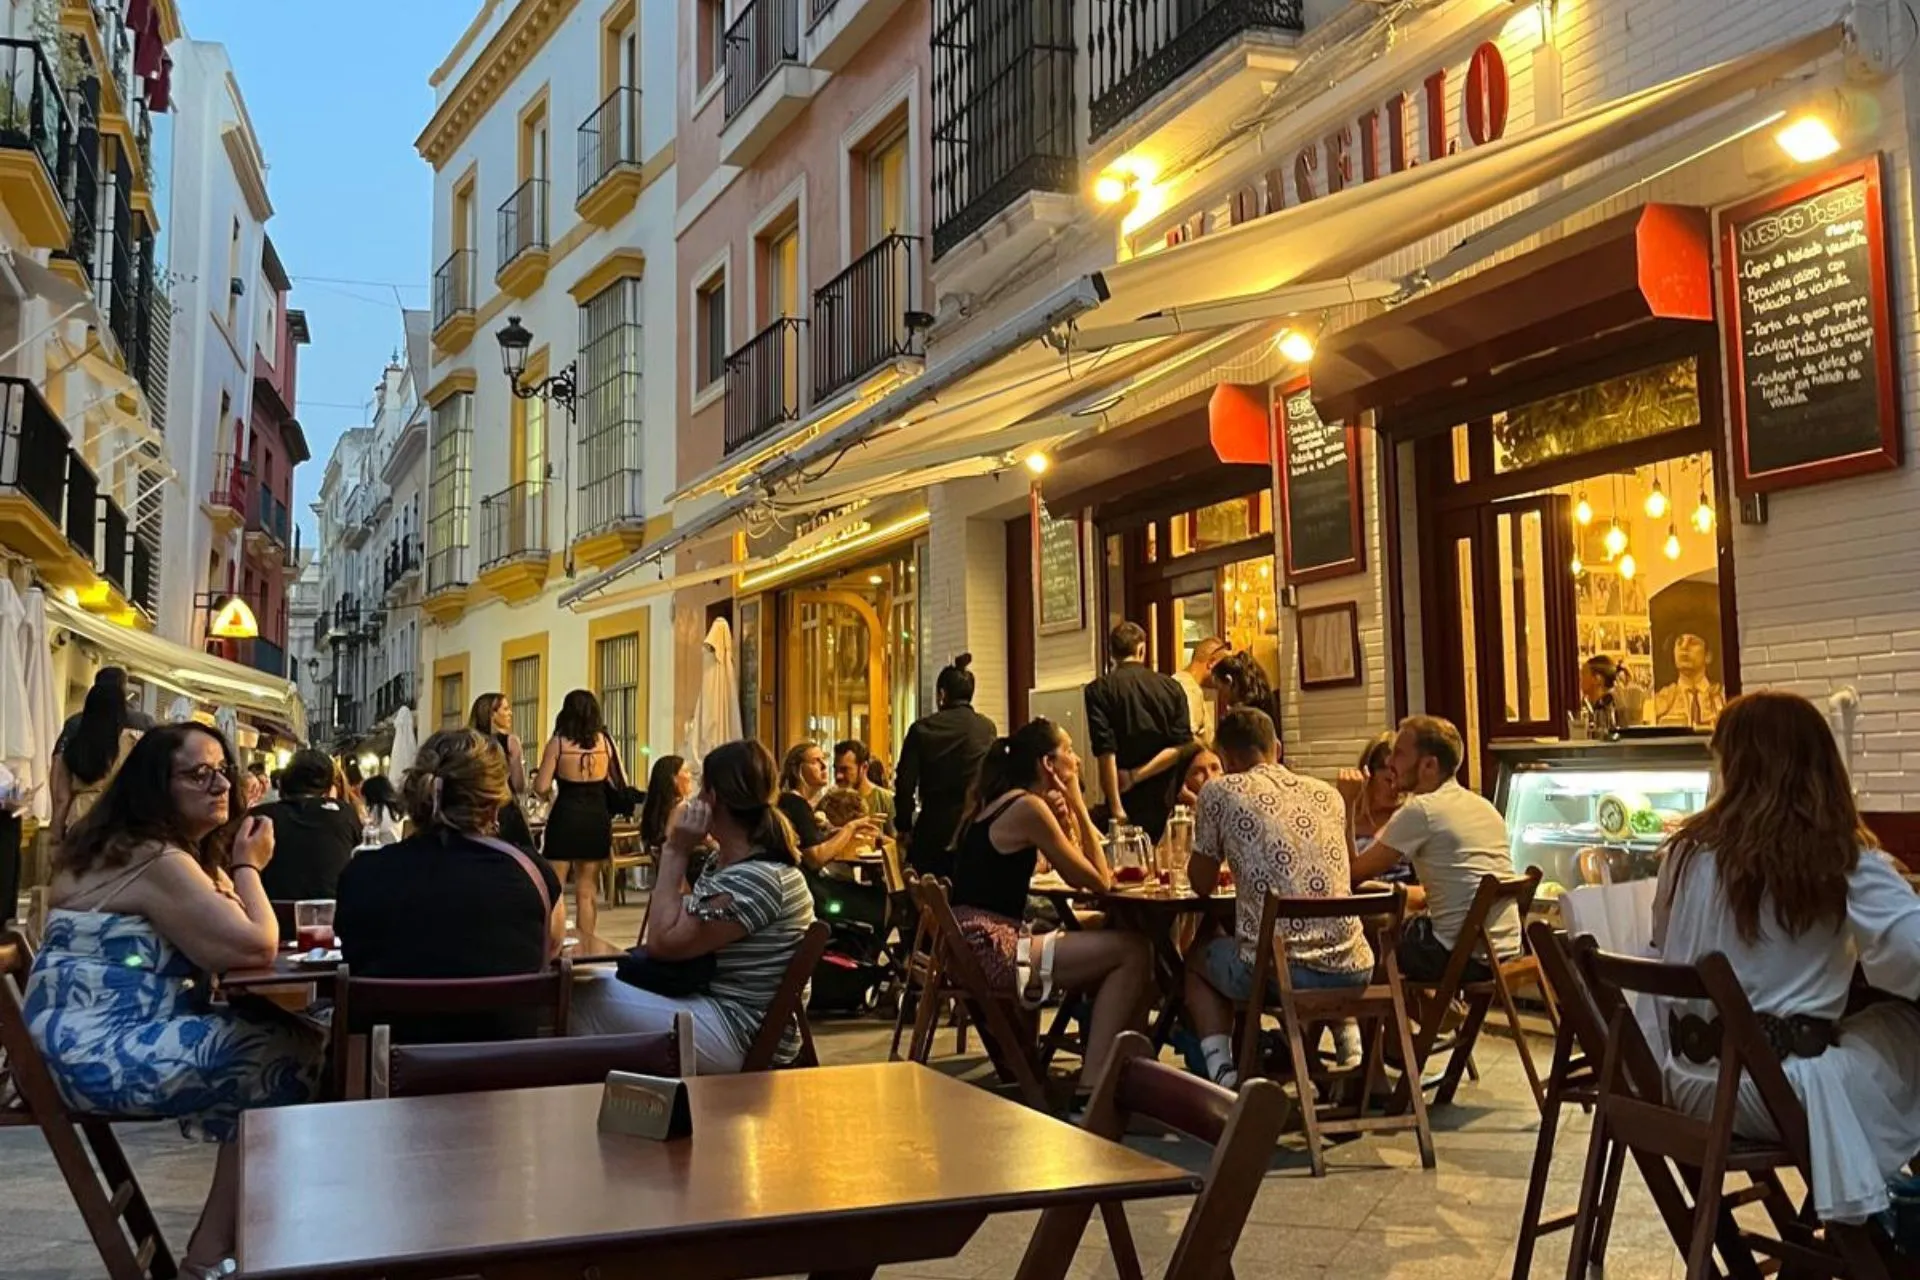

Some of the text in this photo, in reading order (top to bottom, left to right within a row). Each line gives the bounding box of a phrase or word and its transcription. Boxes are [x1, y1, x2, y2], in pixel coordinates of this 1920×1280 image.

[1772, 253, 1786, 269] de
[1827, 260, 1845, 272] con
[1753, 294, 1791, 314] helado
[1794, 288, 1809, 300] de
[1785, 313, 1800, 326] de
[1802, 331, 1816, 343] de
[1830, 336, 1844, 348] de
[1802, 362, 1818, 376] de
